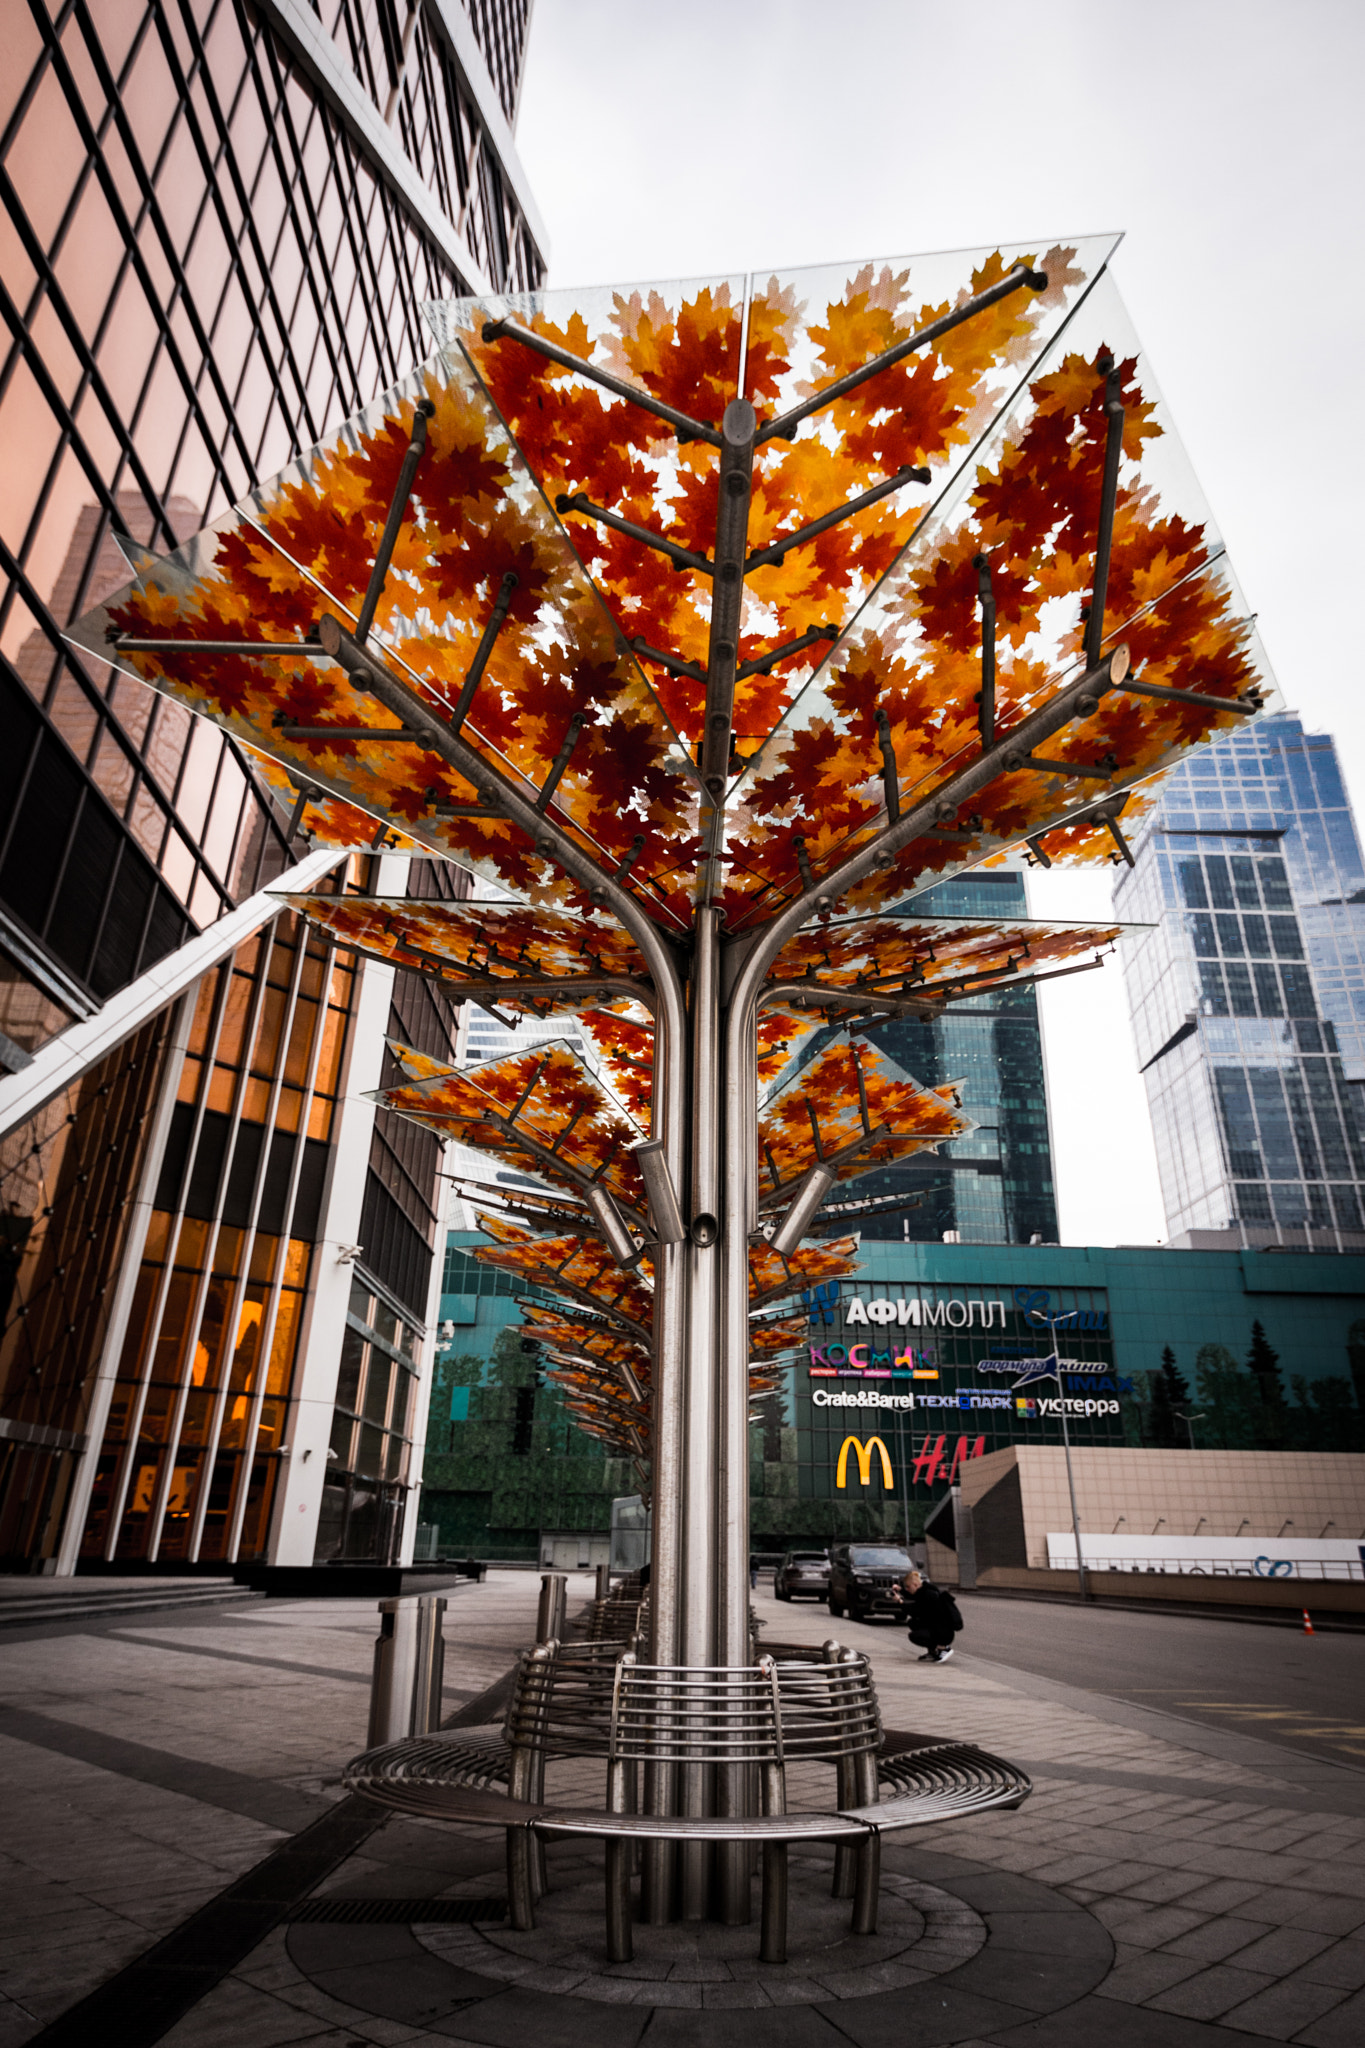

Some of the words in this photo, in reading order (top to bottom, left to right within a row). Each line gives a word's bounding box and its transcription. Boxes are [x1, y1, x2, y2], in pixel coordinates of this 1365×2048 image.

[845, 1297, 1006, 1328] АФИМОЛЛ
[1066, 1375, 1136, 1392] IMAX
[812, 1389, 914, 1408] Crate&Barrel
[916, 1395, 1013, 1410] ТЕХНОПАРК
[1037, 1397, 1121, 1419] уютерра
